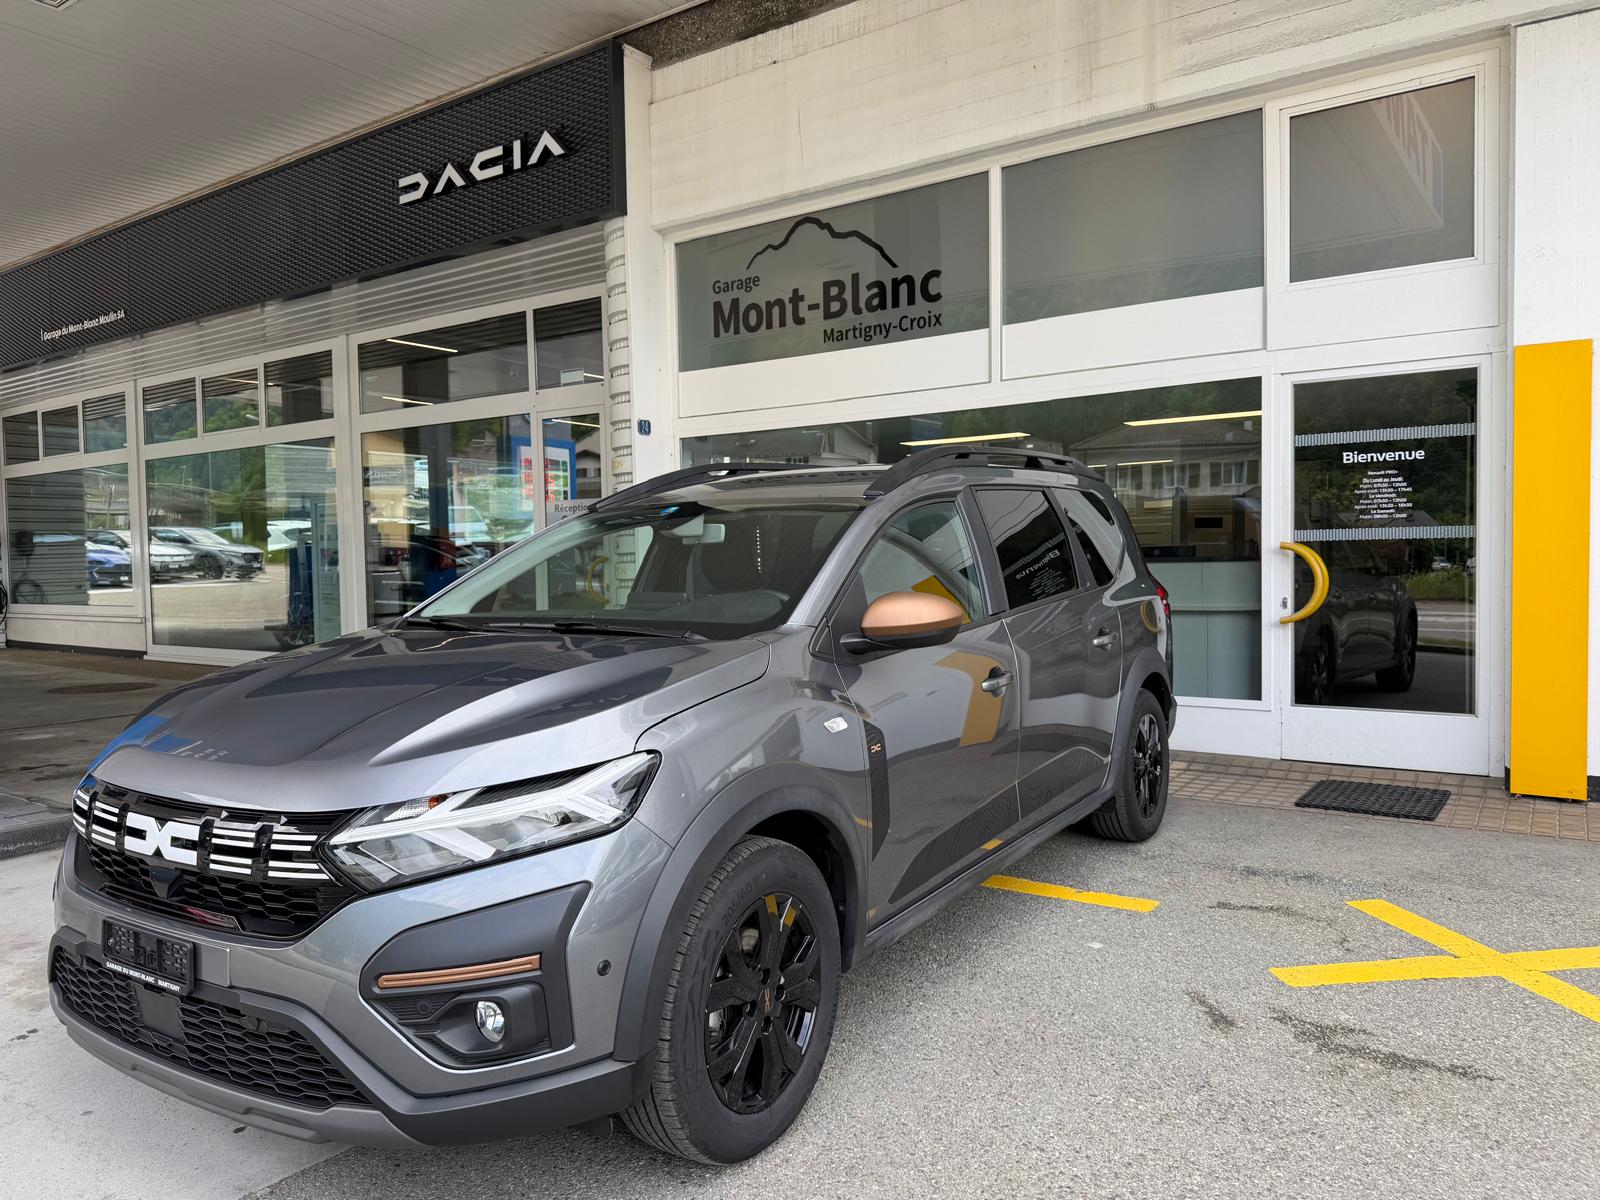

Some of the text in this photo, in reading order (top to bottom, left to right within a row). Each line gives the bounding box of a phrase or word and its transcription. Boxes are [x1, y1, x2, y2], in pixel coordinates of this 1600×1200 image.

[398, 129, 565, 205] DACIA
[712, 273, 761, 295] Garage
[712, 268, 944, 338] Mont-Blanc
[43, 310, 125, 340] Garage du Mont-Blanc Moulin SA
[823, 311, 943, 344] Martigny-Croix
[1342, 450, 1425, 463] Bienvenue
[554, 503, 591, 514] Réceptio
[106, 961, 180, 992] GARAGE DU MONT-BLANC MARTIGNY
